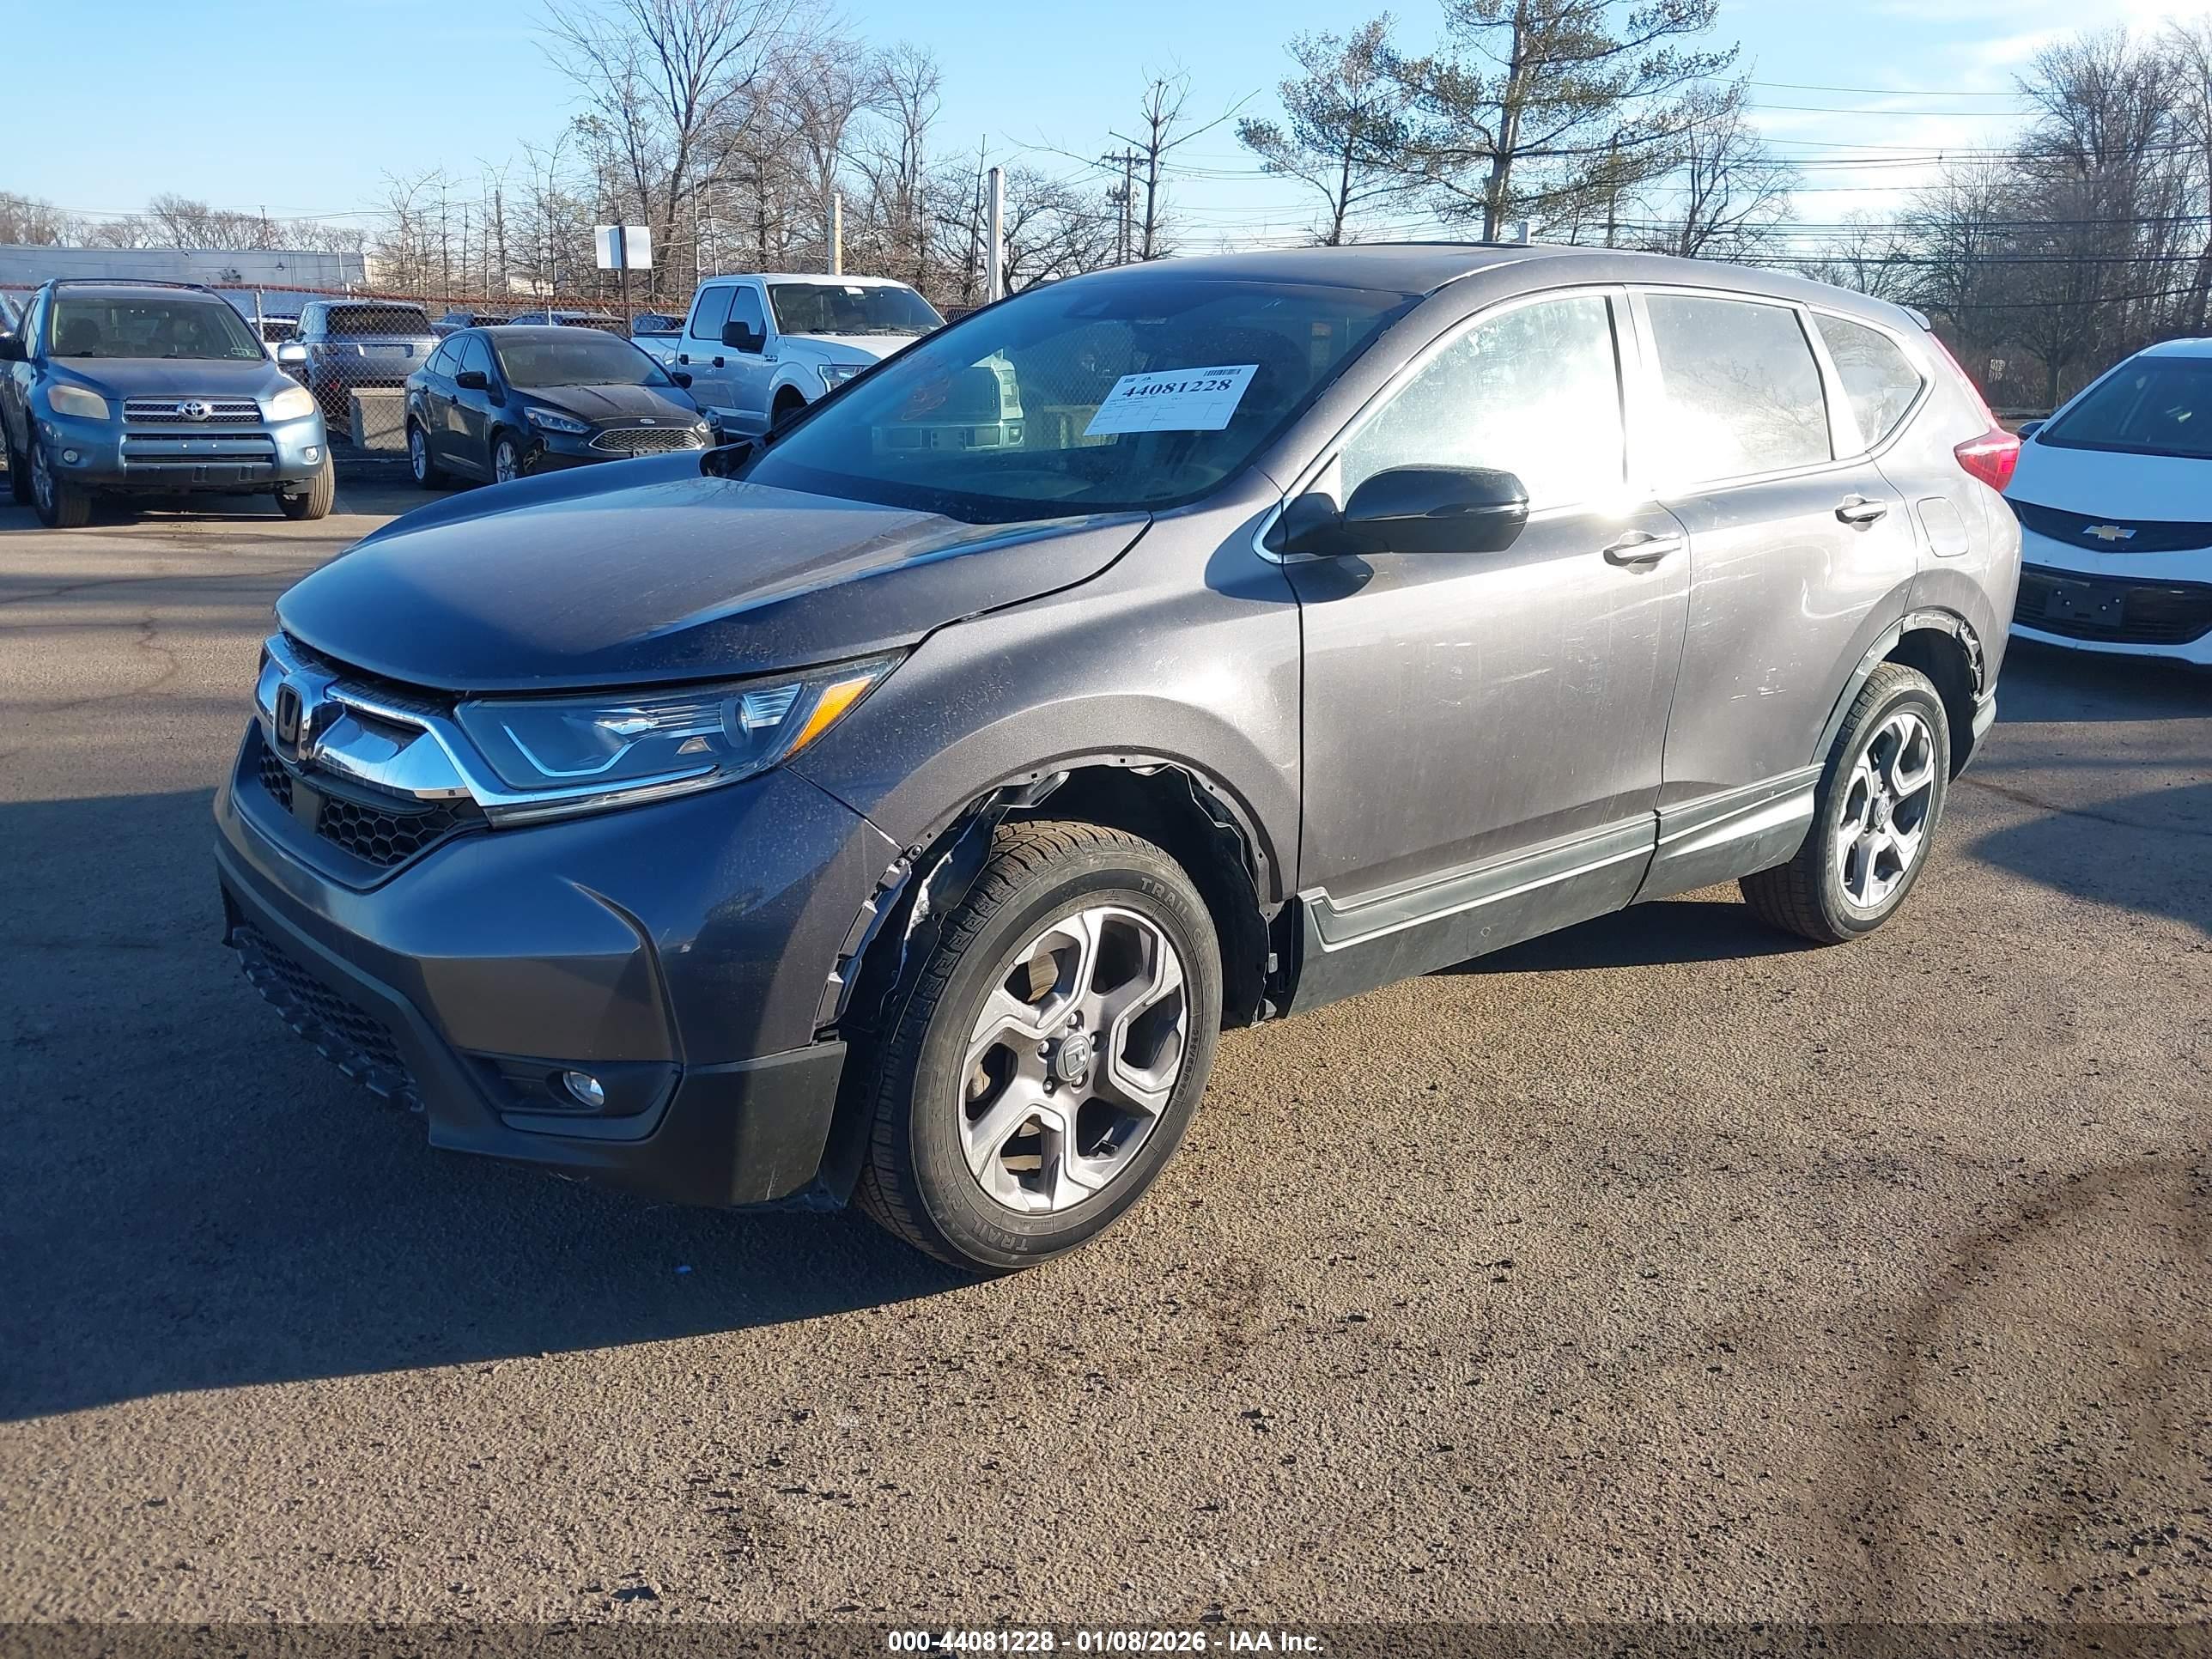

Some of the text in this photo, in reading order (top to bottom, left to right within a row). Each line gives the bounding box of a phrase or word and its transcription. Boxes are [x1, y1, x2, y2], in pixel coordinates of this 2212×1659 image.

[1122, 379, 1231, 397] 44081228
[1140, 877, 1189, 924] TRAIL
[971, 1216, 1028, 1250] TRAIL
